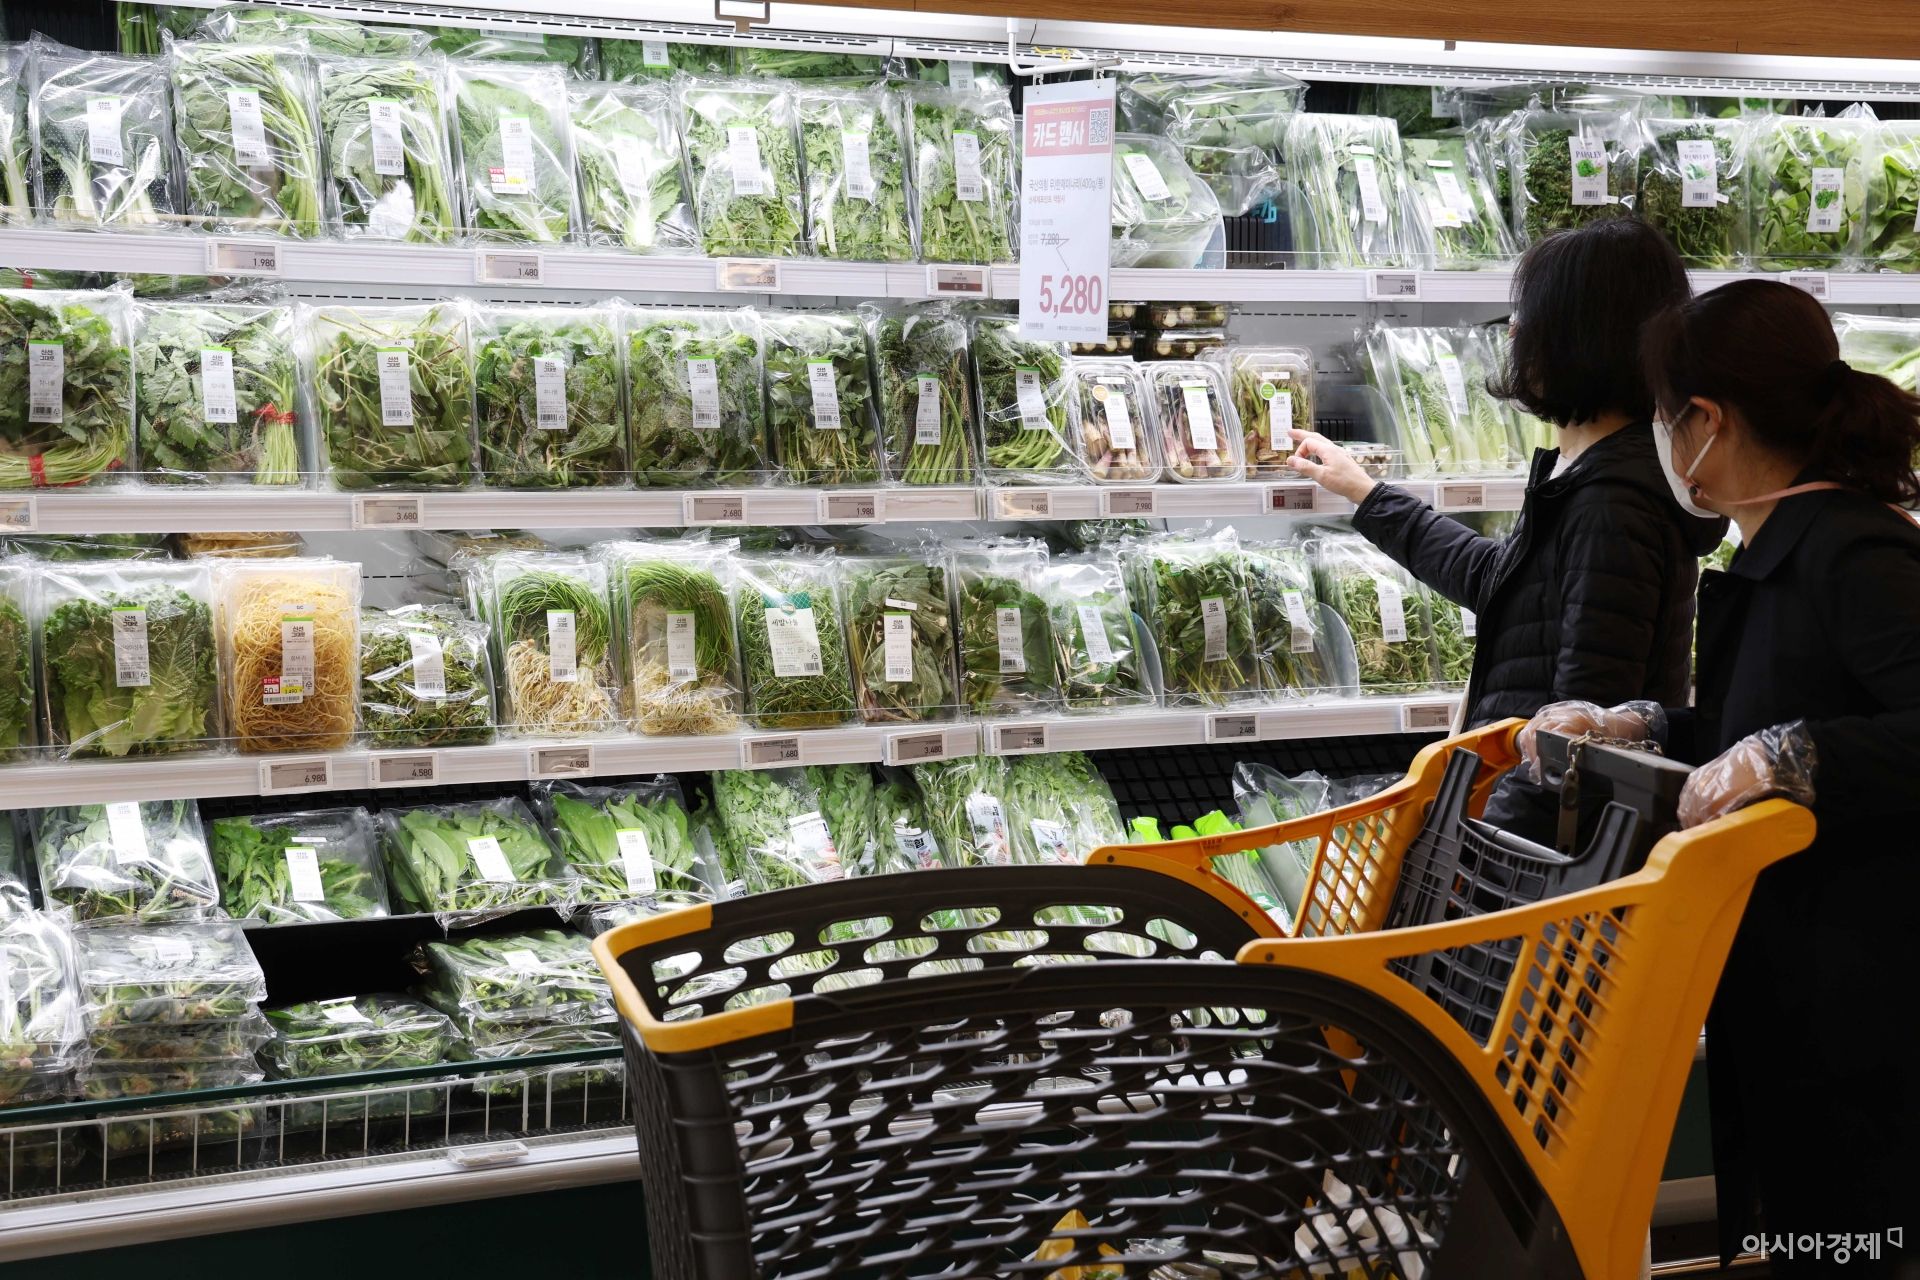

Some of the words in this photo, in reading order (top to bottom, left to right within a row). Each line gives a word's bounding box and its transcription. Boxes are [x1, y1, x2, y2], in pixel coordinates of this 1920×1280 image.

[1033, 122, 1057, 147] 카드
[1060, 120, 1085, 147] 행사
[1040, 274, 1102, 319] 5,280
[772, 618, 799, 627] 세발나물
